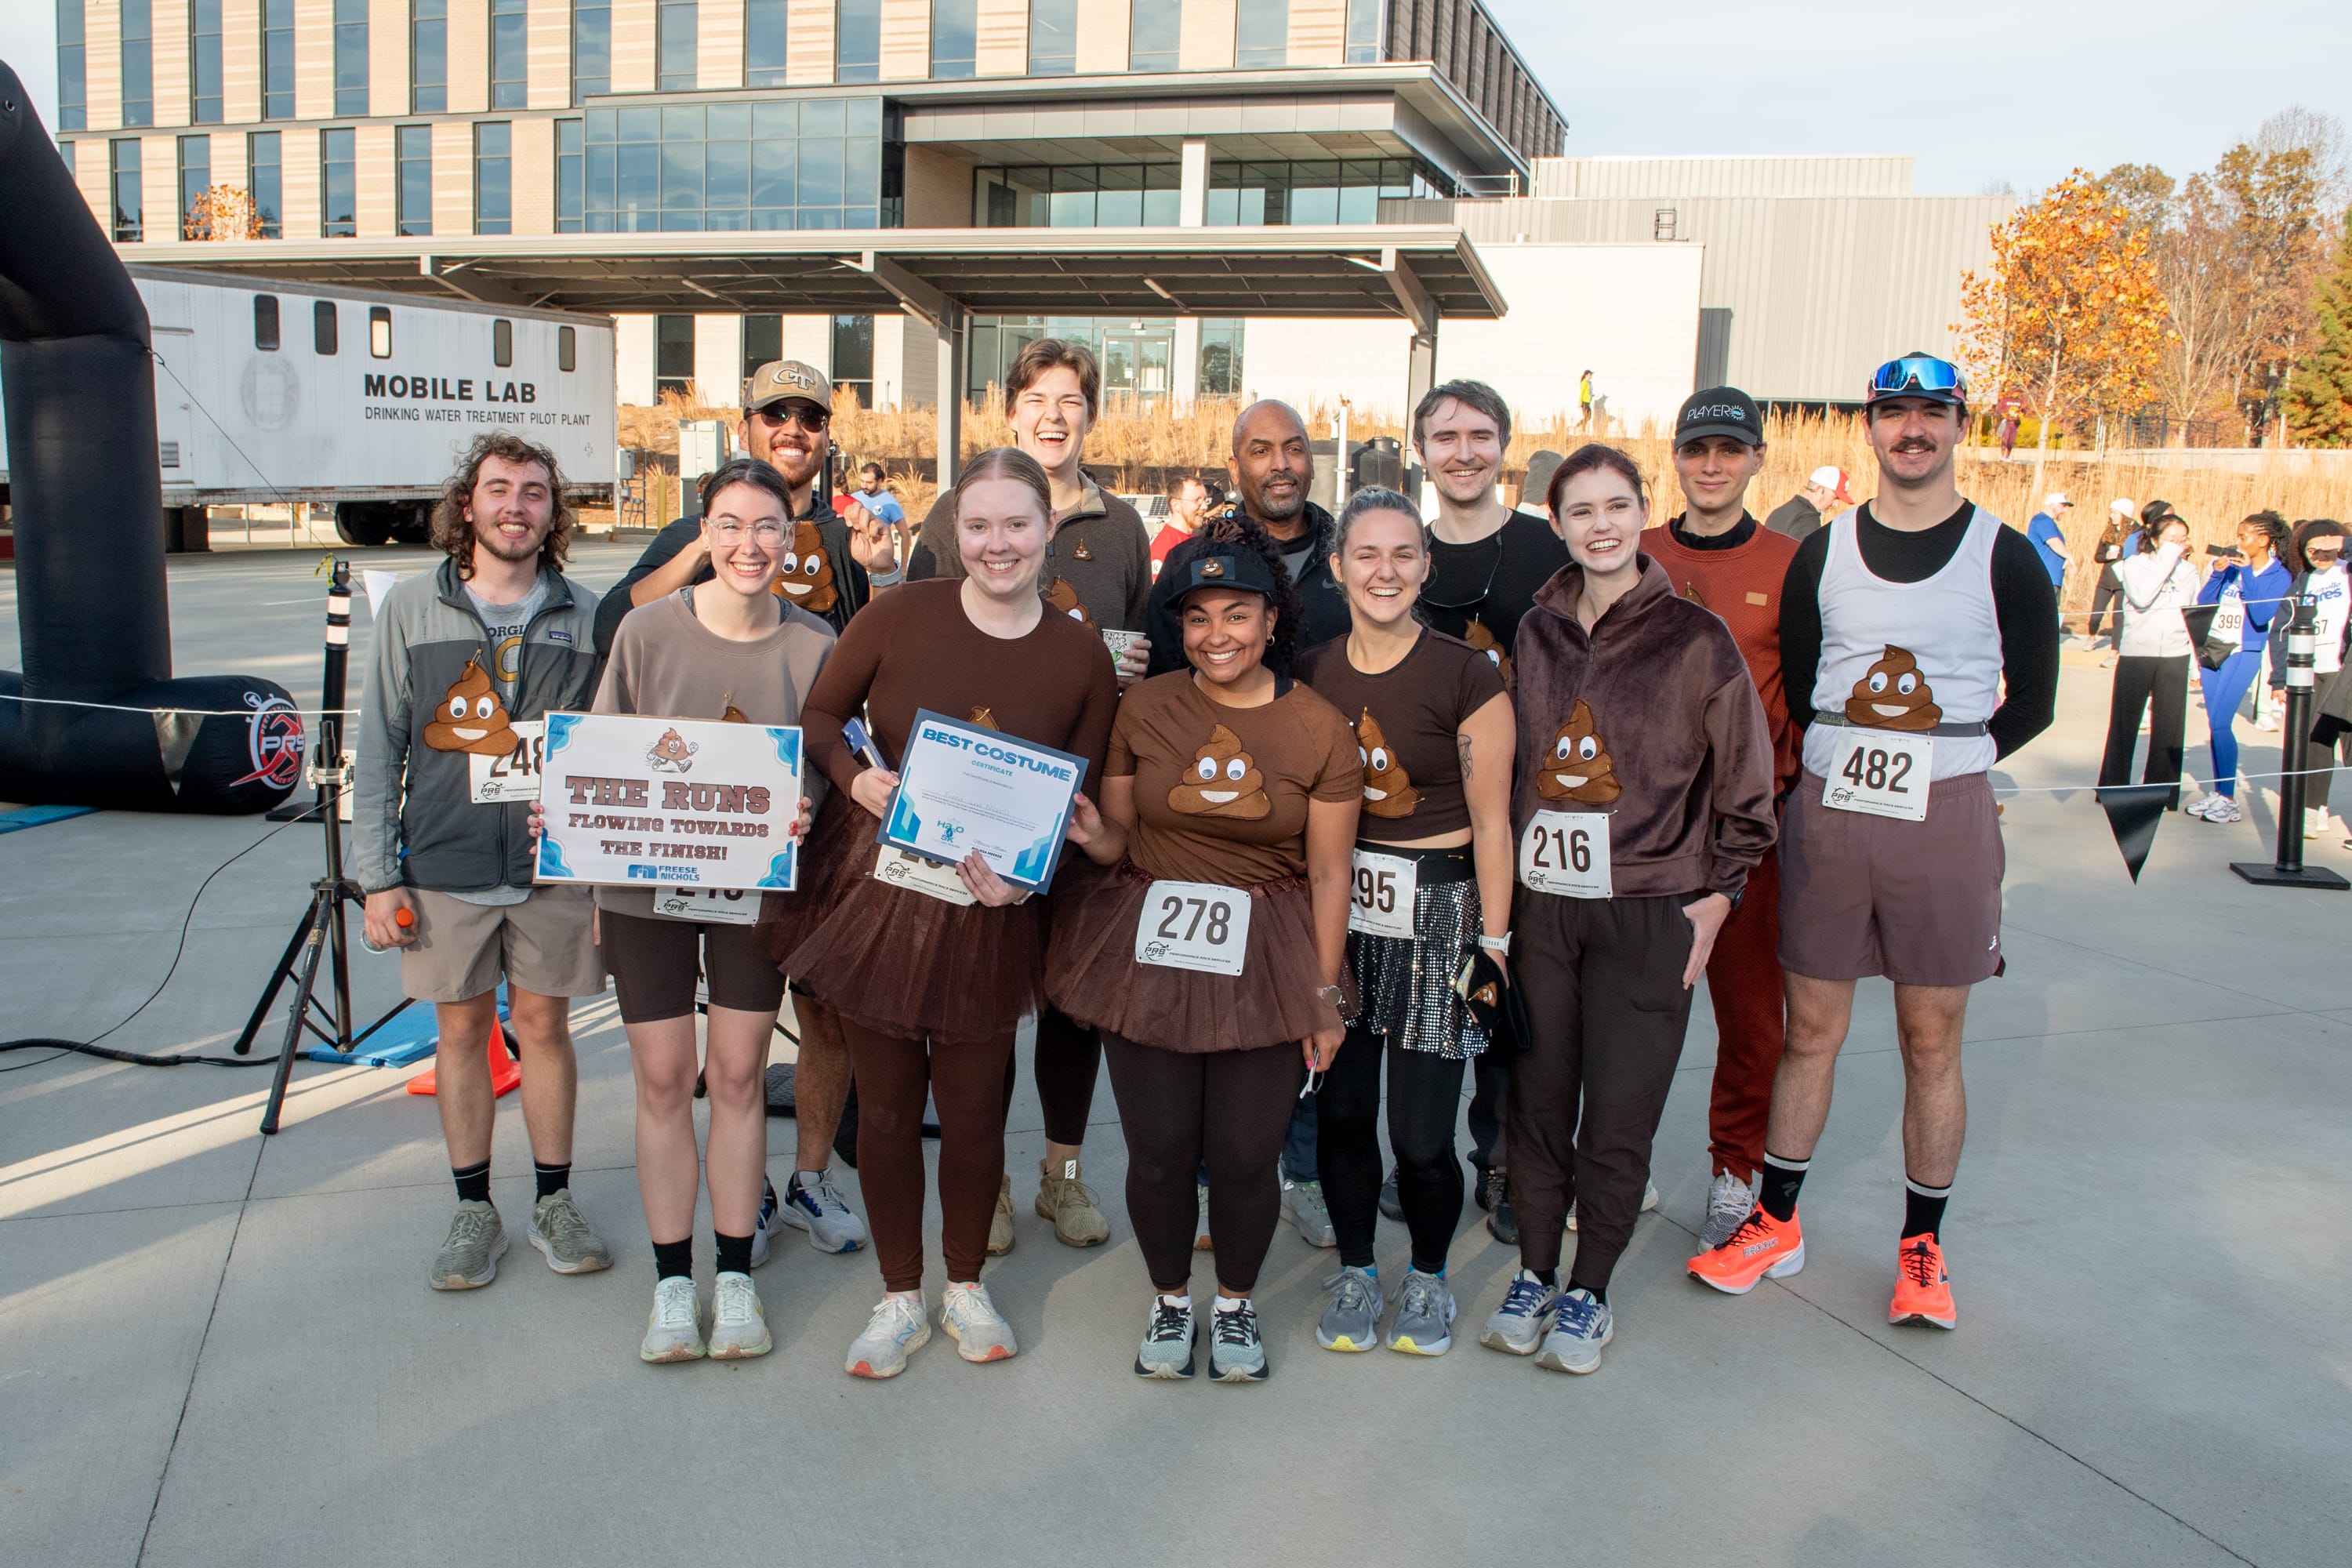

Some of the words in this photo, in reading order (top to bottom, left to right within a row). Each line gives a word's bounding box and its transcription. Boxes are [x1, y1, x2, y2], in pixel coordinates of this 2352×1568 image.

[364, 374, 474, 401] MOBILE
[486, 380, 536, 403] LAB
[772, 367, 815, 390] GT
[365, 407, 419, 421] DRINKING
[425, 409, 461, 422] WATER
[466, 410, 526, 424] TREATMENT
[530, 413, 557, 425] PILOT
[561, 414, 591, 426] PLANT
[488, 624, 528, 637] ORGI
[2218, 614, 2242, 629] 399
[260, 735, 305, 754] PRS
[922, 728, 973, 750] BEST
[974, 742, 1072, 782] COSTUME
[971, 760, 1013, 776] CERTIFICATE
[1842, 746, 1913, 794] 482
[565, 775, 649, 808] THE
[662, 781, 771, 814] RUNS
[1831, 792, 1851, 801] PRS
[568, 813, 664, 833] FLOWING
[670, 818, 769, 837] TOWARDS
[601, 840, 642, 857] THE
[649, 843, 728, 861] FINISH!
[1534, 825, 1591, 873] 216
[659, 866, 698, 874] FREESE
[661, 873, 700, 881] NICHOLS
[1352, 866, 1396, 913] 95
[1157, 895, 1232, 946] 278
[1145, 946, 1166, 955] PRS
